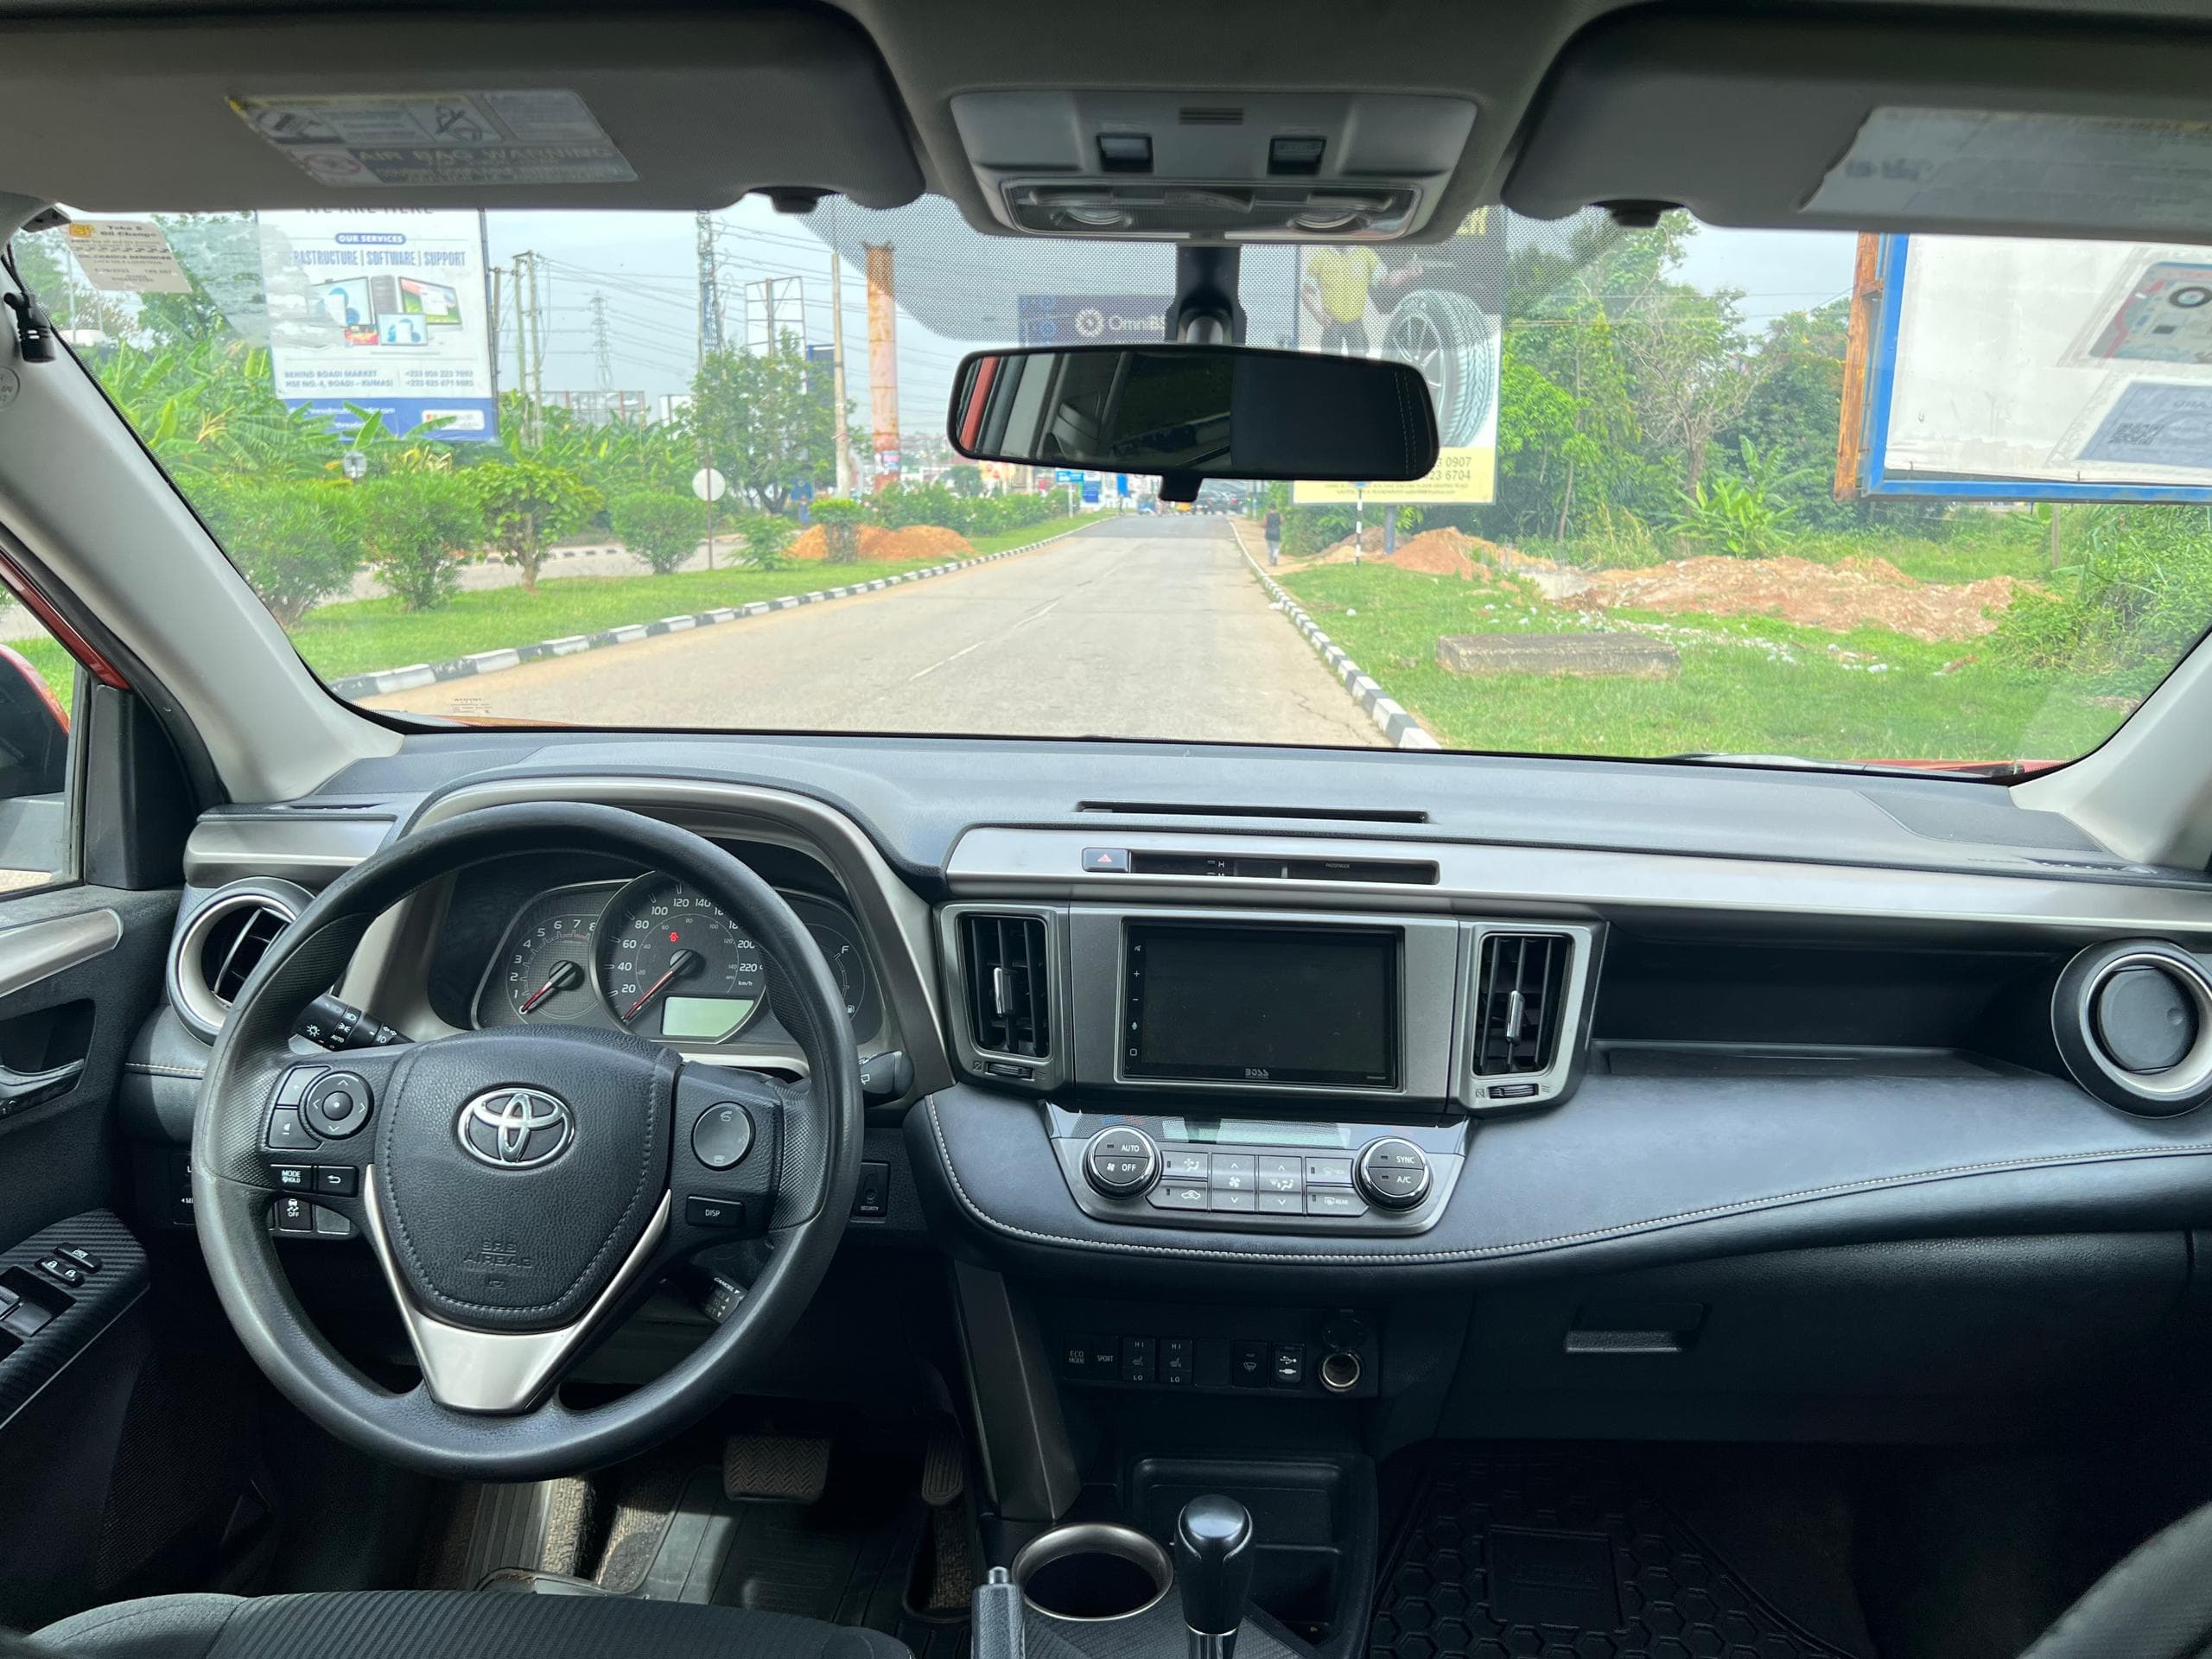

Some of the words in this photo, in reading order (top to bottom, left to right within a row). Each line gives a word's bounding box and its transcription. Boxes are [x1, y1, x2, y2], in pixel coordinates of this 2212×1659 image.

[338, 234, 359, 243] OUR
[361, 234, 404, 243] SERVICES
[289, 250, 359, 266] RASTRUCTURE
[366, 250, 416, 266] SOFTWARE
[424, 251, 466, 266] SUPPORT
[1446, 456, 1471, 467] 0907
[1445, 470, 1471, 481] 6704
[673, 898, 690, 907] 120
[651, 906, 669, 916] 100
[554, 920, 563, 930] 6
[573, 919, 582, 929] 7
[634, 920, 650, 930] 80
[537, 928, 546, 937] 5
[523, 939, 531, 949] 4
[622, 939, 637, 949] 60
[842, 945, 850, 954] F
[513, 955, 523, 963] 3
[617, 962, 632, 971] 40
[739, 963, 758, 972] 220
[510, 972, 518, 982] 2
[621, 984, 636, 993] 20
[513, 989, 518, 999] 1
[330, 1034, 345, 1044] AUTO
[1121, 1144, 1140, 1153] AUTO
[1395, 1155, 1414, 1164] SYNC
[1121, 1163, 1136, 1172] OFF
[714, 1277, 734, 1292] CANCEL
[1096, 1354, 1114, 1363] SPORT
